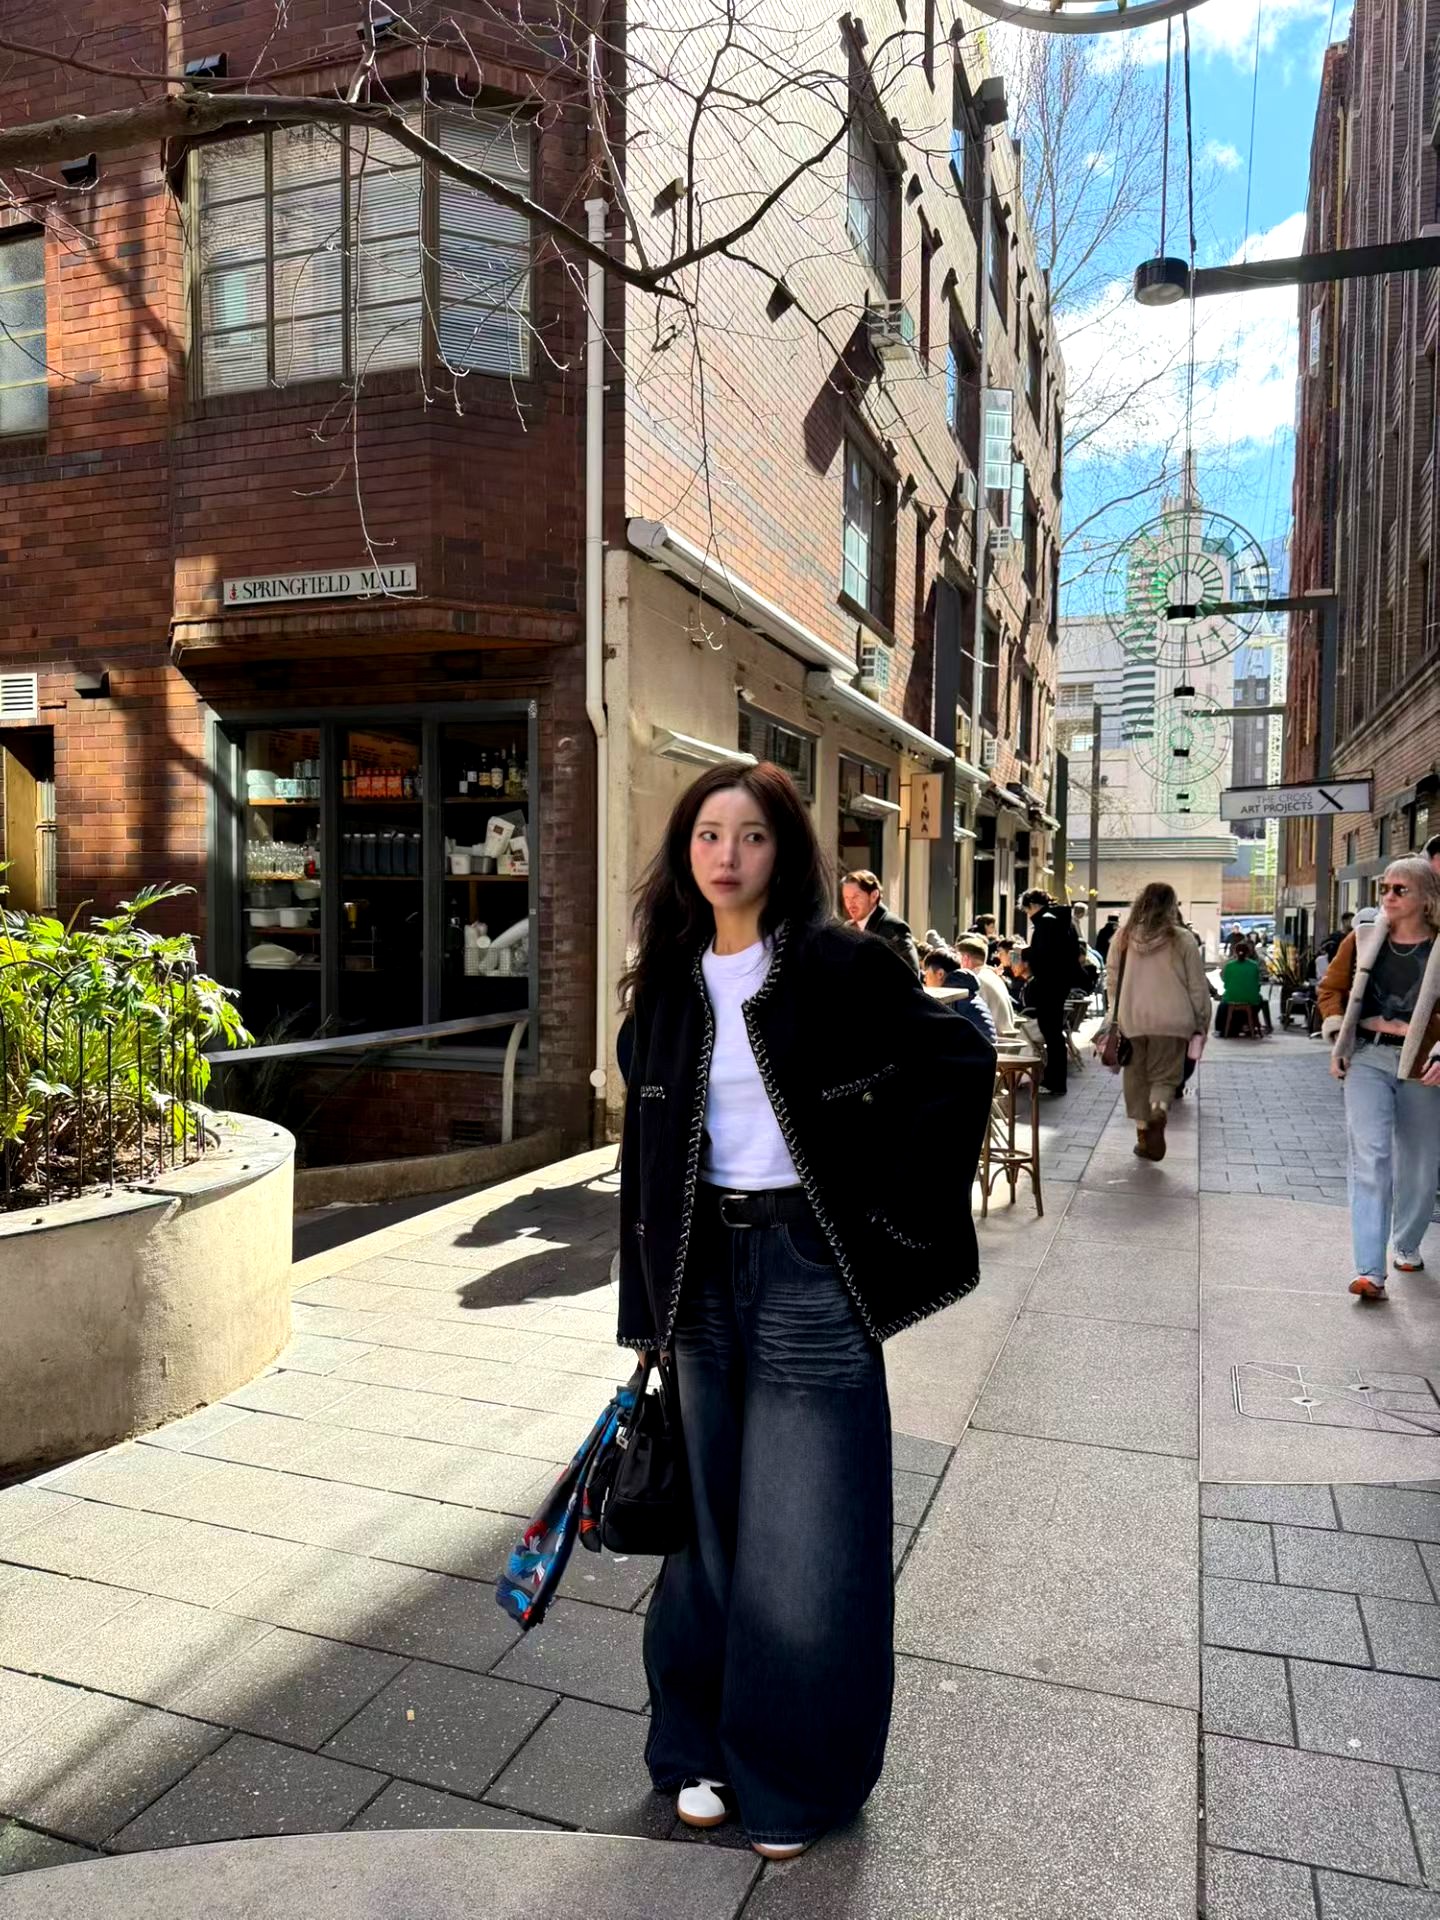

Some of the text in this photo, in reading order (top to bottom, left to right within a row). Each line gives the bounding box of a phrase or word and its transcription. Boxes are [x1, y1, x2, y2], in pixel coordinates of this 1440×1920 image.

[243, 569, 411, 599] SPRINGFIELD MALL
[1257, 792, 1313, 804] THE CROSS
[1240, 801, 1313, 814] ART PROJECTS
